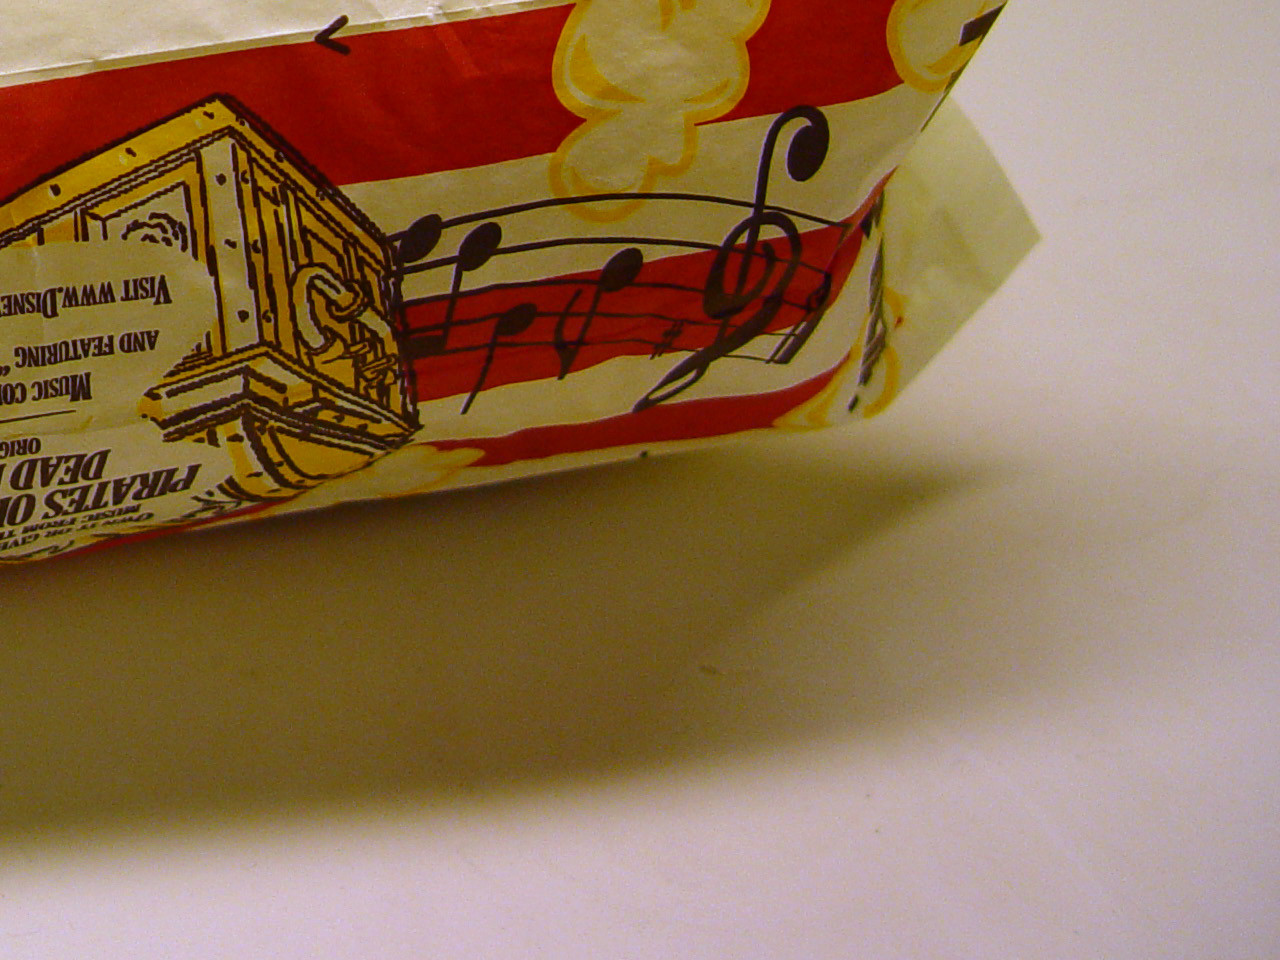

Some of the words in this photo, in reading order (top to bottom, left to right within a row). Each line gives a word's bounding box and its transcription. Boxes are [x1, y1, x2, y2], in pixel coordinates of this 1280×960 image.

[10, 449, 110, 491] DEAD
[33, 464, 201, 514] PIRATES
[21, 518, 77, 535] FROM
